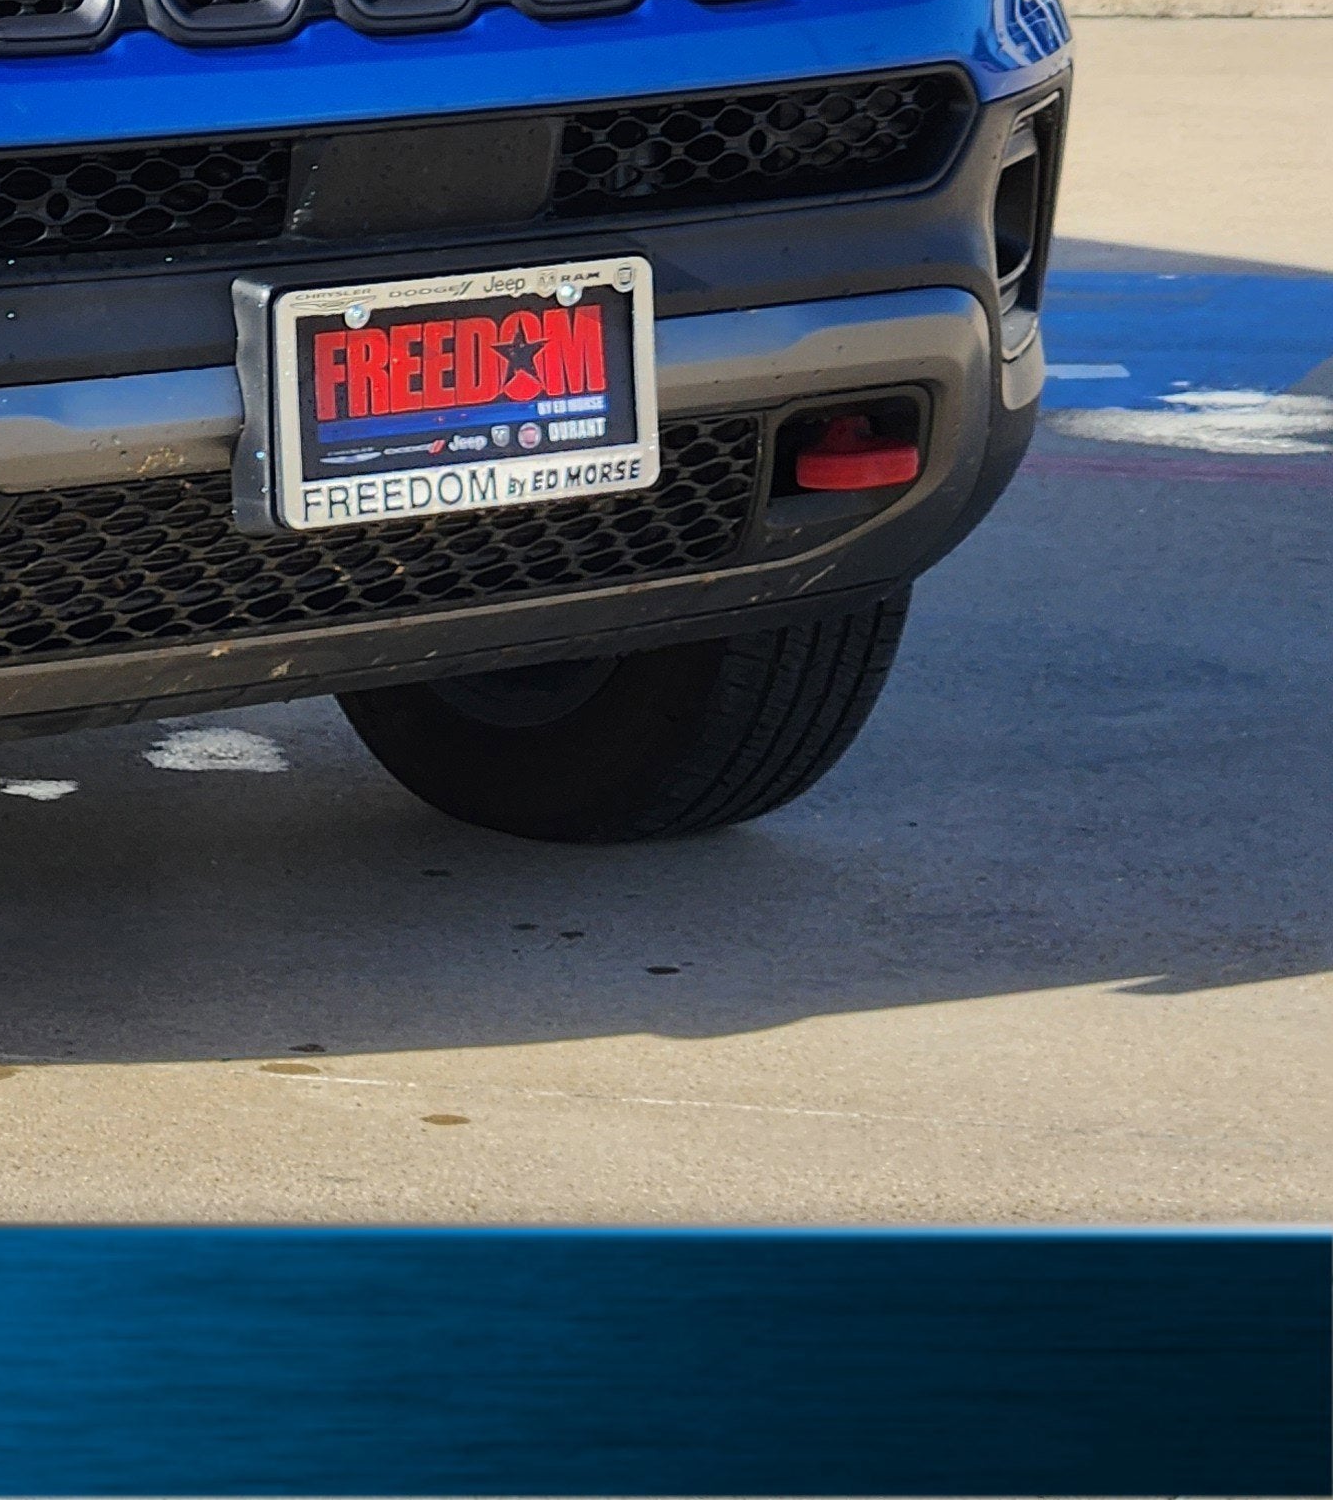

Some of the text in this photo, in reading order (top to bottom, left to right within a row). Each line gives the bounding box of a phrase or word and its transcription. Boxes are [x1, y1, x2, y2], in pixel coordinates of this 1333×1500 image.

[483, 276, 526, 296] Jeep
[561, 271, 600, 282] RAM
[314, 304, 606, 422] FREEDOM
[303, 467, 498, 521] FREEDOM
[532, 469, 559, 491] ED
[564, 459, 641, 489] MORSE
